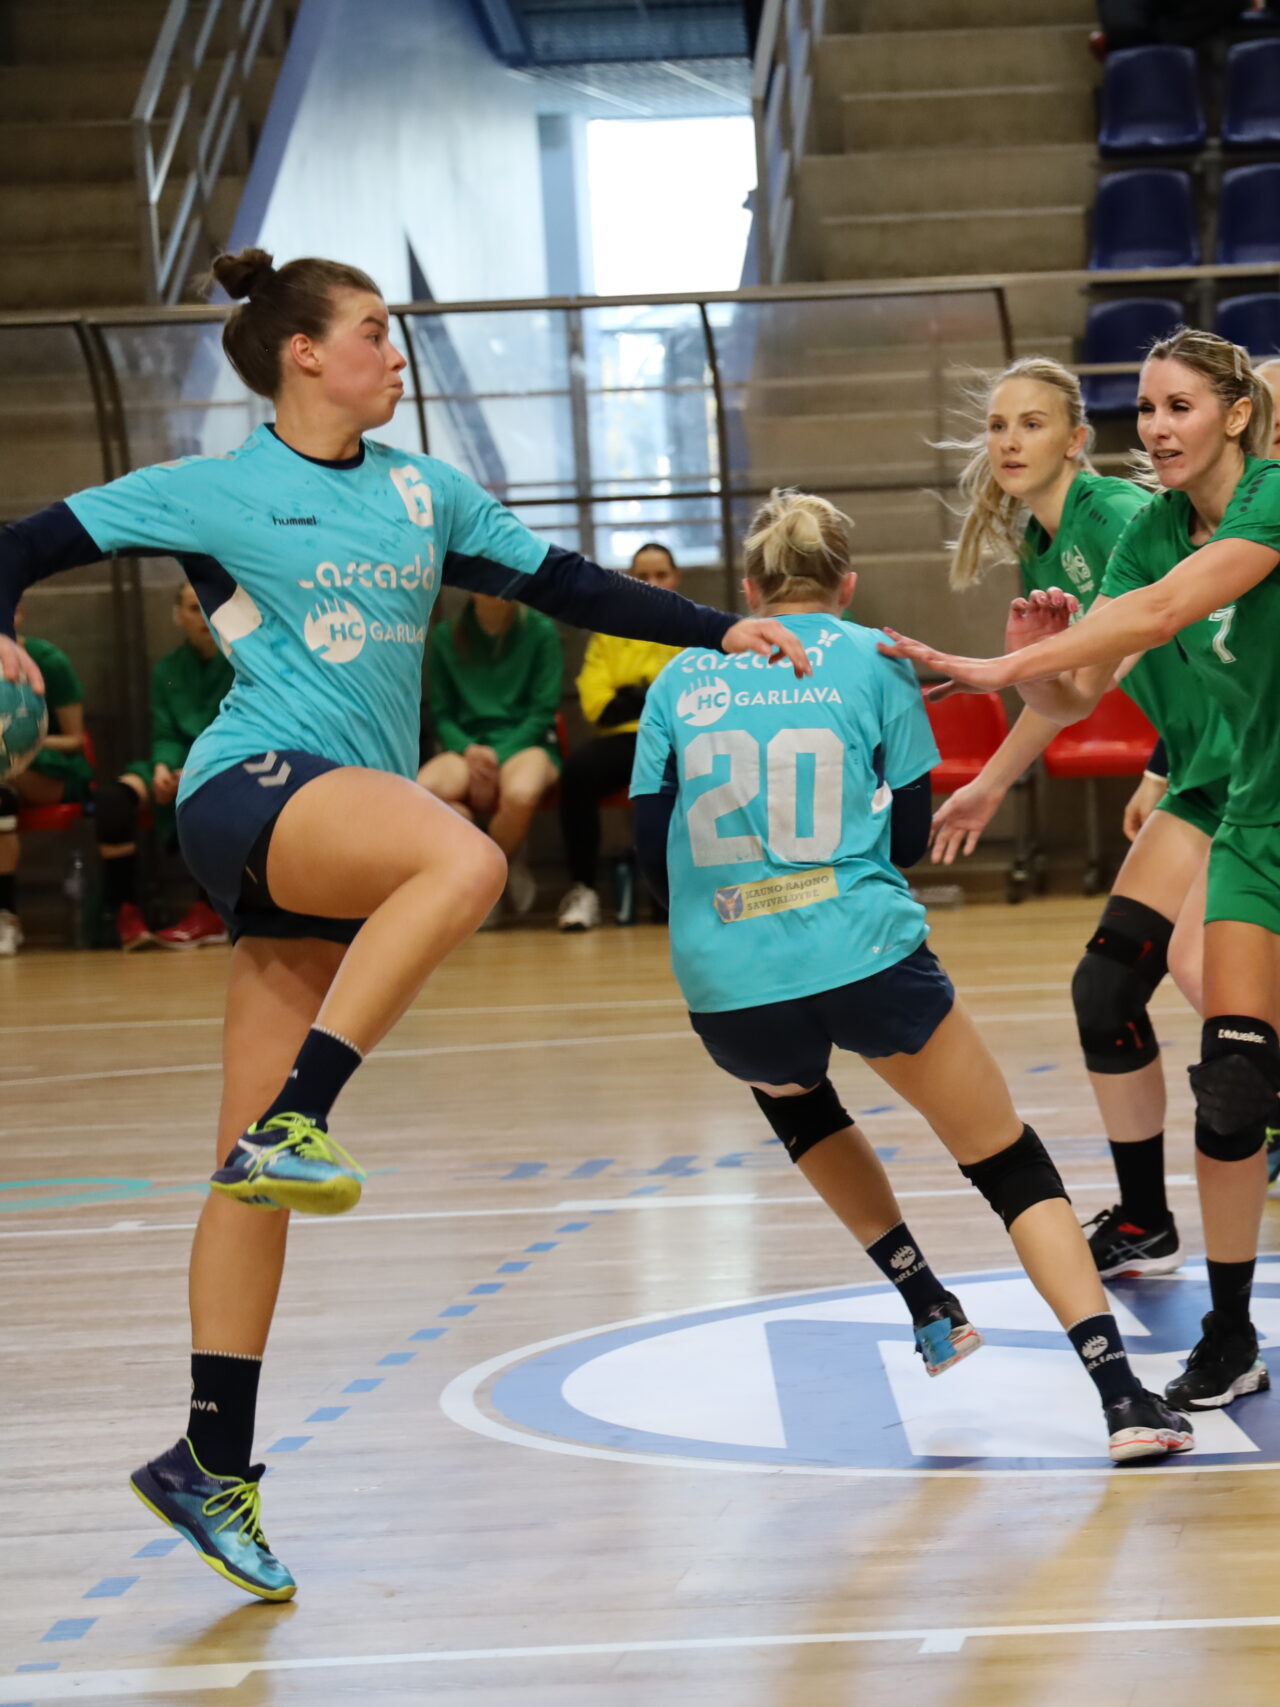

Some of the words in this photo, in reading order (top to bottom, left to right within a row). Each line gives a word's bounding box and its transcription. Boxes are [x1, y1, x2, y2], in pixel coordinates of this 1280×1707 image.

[390, 464, 435, 527] 6
[272, 514, 317, 526] hummel
[329, 622, 363, 641] HC
[1208, 604, 1237, 664] 7
[697, 691, 727, 710] HC
[734, 686, 843, 706] GARLIAVA
[684, 728, 844, 867] 20
[745, 884, 783, 899] KAUNO
[785, 875, 830, 892] RAJONO
